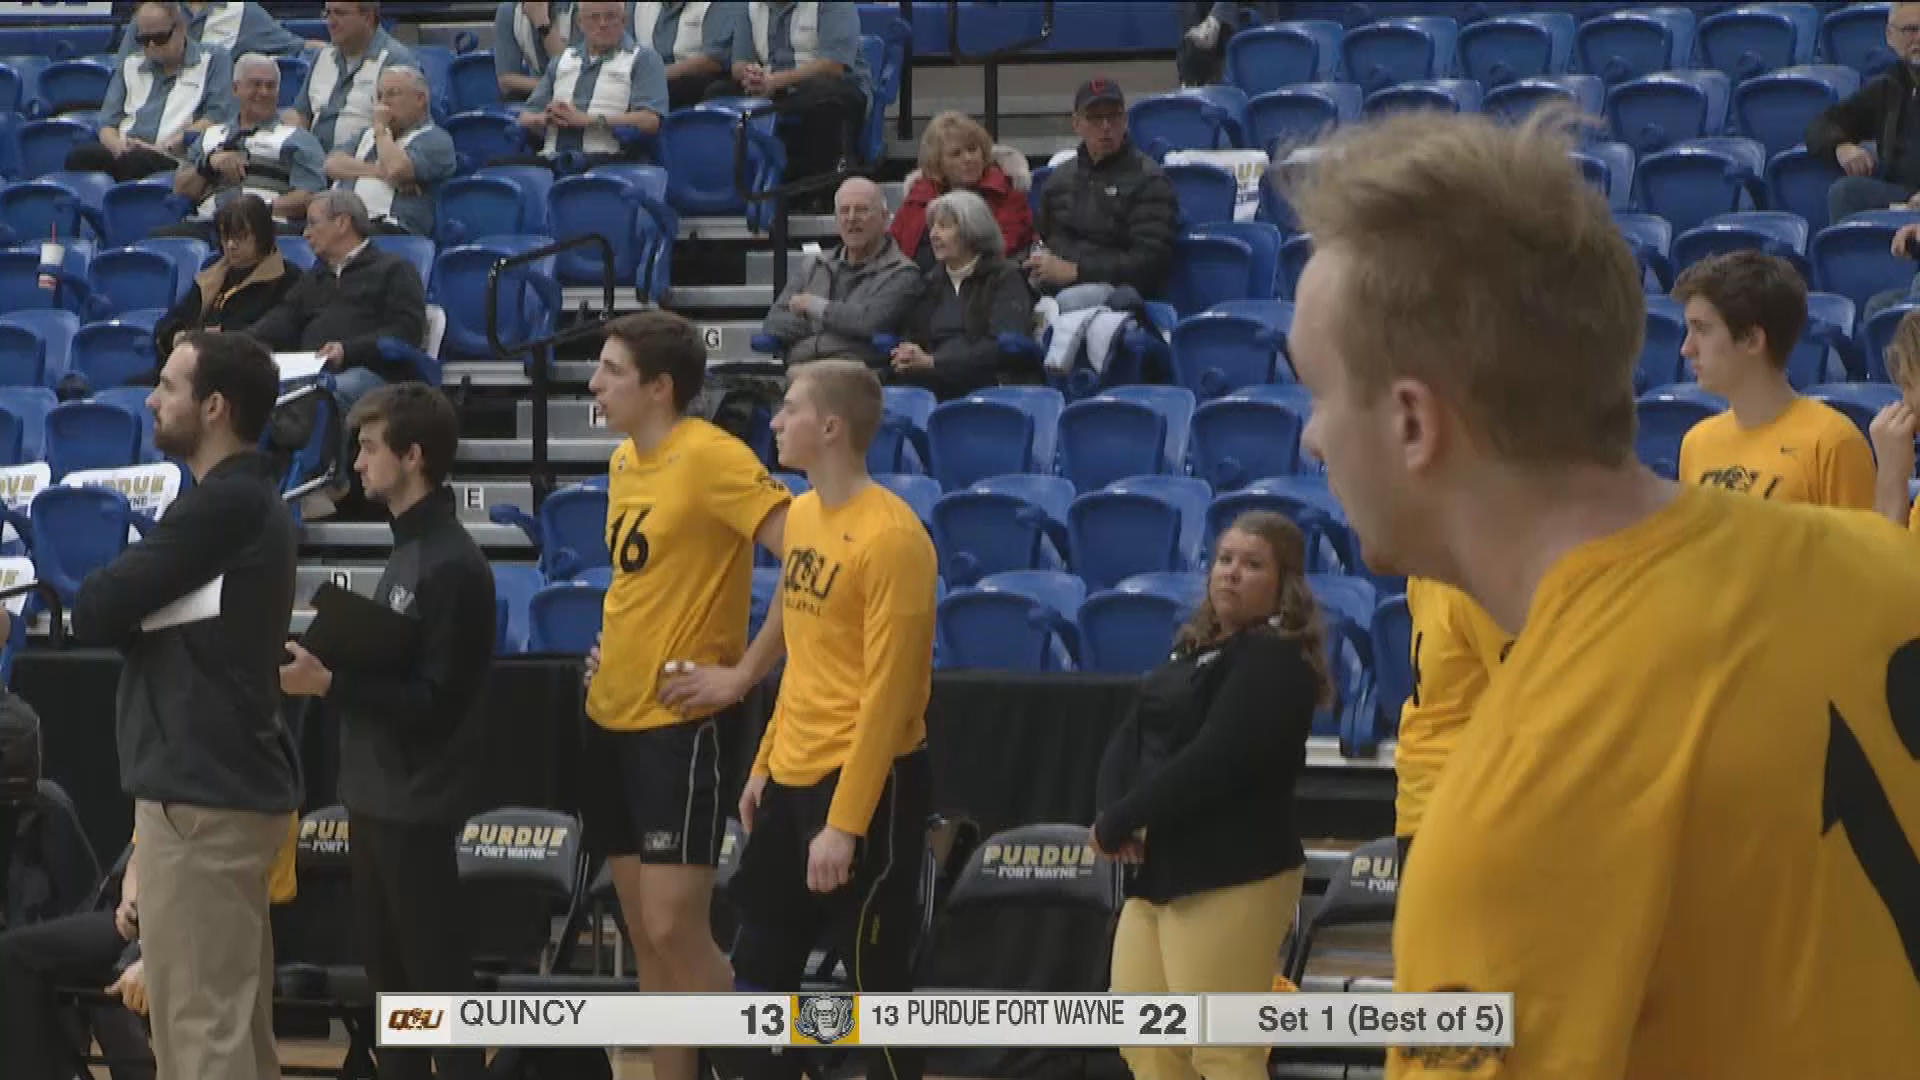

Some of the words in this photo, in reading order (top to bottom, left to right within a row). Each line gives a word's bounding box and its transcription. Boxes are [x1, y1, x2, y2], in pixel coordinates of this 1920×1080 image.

[705, 328, 719, 348] G
[467, 488, 482, 509] E
[611, 505, 653, 574] 16
[301, 820, 349, 842] PUR
[462, 823, 569, 848] PURDUE
[474, 844, 505, 858] FORT
[507, 846, 546, 860] WAYNE
[998, 865, 1032, 879] FORT
[1034, 866, 1078, 880] WAYNE
